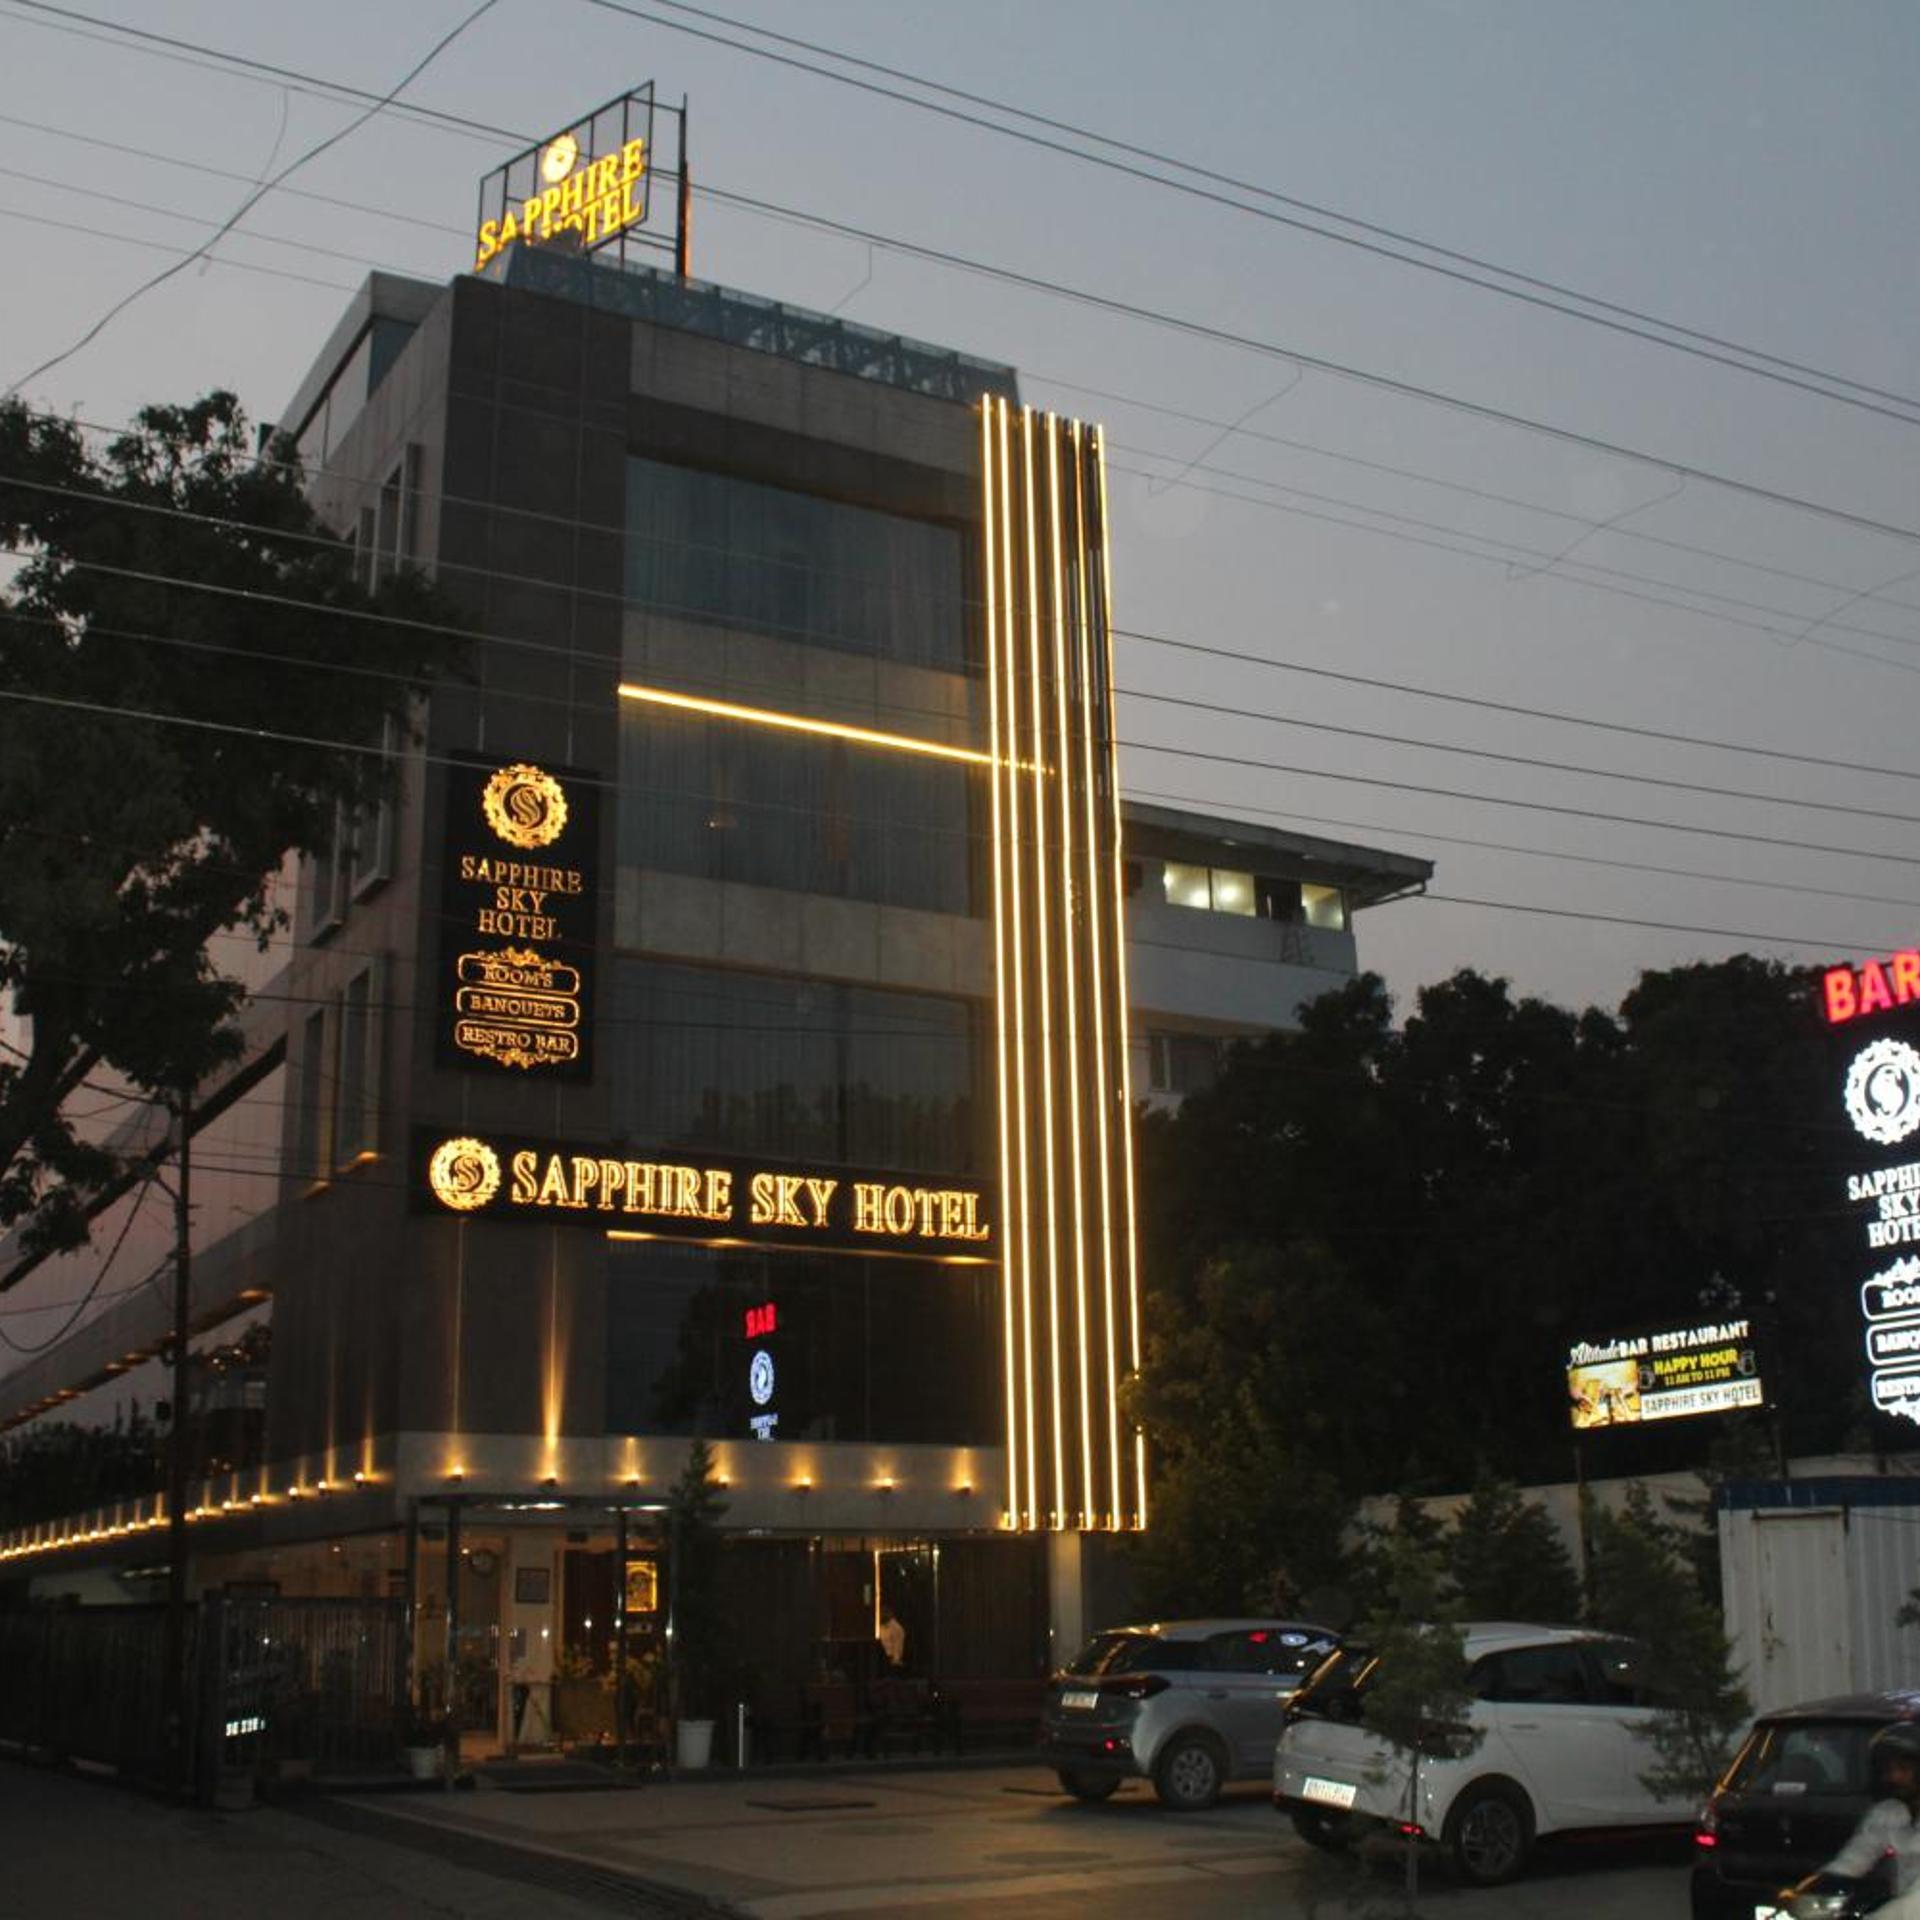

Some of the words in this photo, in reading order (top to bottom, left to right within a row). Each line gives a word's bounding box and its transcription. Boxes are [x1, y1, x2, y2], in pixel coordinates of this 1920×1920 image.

[476, 138, 643, 263] SAPPHIRE
[461, 856, 582, 893] SAPPHIRE
[496, 886, 548, 914] SKY
[478, 908, 562, 939] HOTEL
[483, 962, 553, 988] ROOMS
[1825, 949, 1920, 1023] BAR
[469, 994, 566, 1018] BANQUETS
[461, 1026, 531, 1048] RESTRO
[535, 1033, 571, 1052] BAR
[511, 1150, 733, 1220] SAPPHIRE
[750, 1172, 838, 1228] SKY
[853, 1183, 989, 1241] HOTEL
[1879, 1189, 1920, 1220] SKY
[1619, 1337, 1648, 1357] BAR
[1652, 1320, 1749, 1352] RESTAURANT
[1653, 1355, 1698, 1376] HAPPY
[1699, 1347, 1738, 1369] HOUR
[1690, 1371, 1703, 1382] TO
[1643, 1393, 1695, 1414] SAPPHIRE
[1699, 1388, 1720, 1407] SKY
[1723, 1382, 1760, 1404] HOTEL
